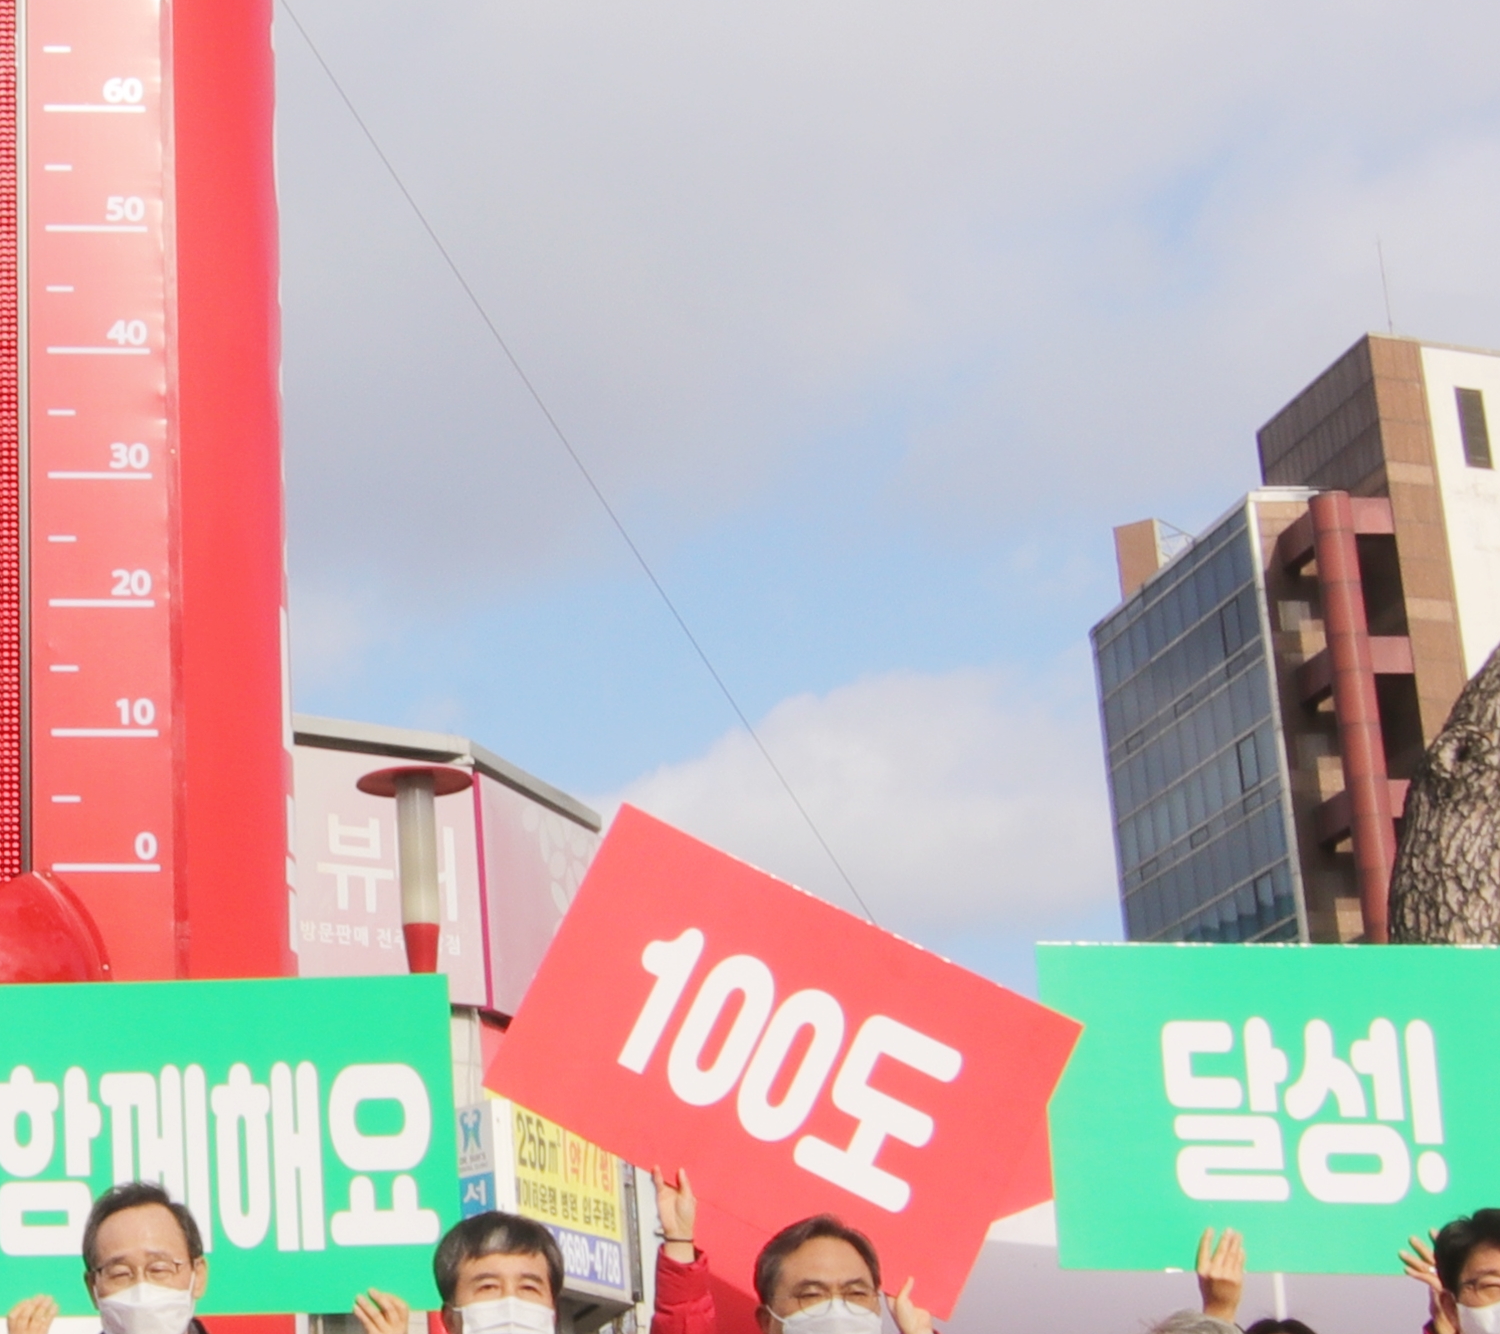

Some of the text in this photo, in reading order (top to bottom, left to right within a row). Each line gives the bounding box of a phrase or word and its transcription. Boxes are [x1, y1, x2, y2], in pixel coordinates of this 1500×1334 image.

[103, 78, 143, 103] 60
[106, 196, 144, 222] 50
[107, 320, 147, 346] 40
[109, 443, 149, 470] 30
[111, 570, 152, 596] 20
[115, 699, 155, 725] 10
[135, 833, 157, 860] 0
[300, 921, 369, 947] 방문판매
[615, 926, 963, 1213] 100도
[1160, 1015, 1449, 1205] 달성!
